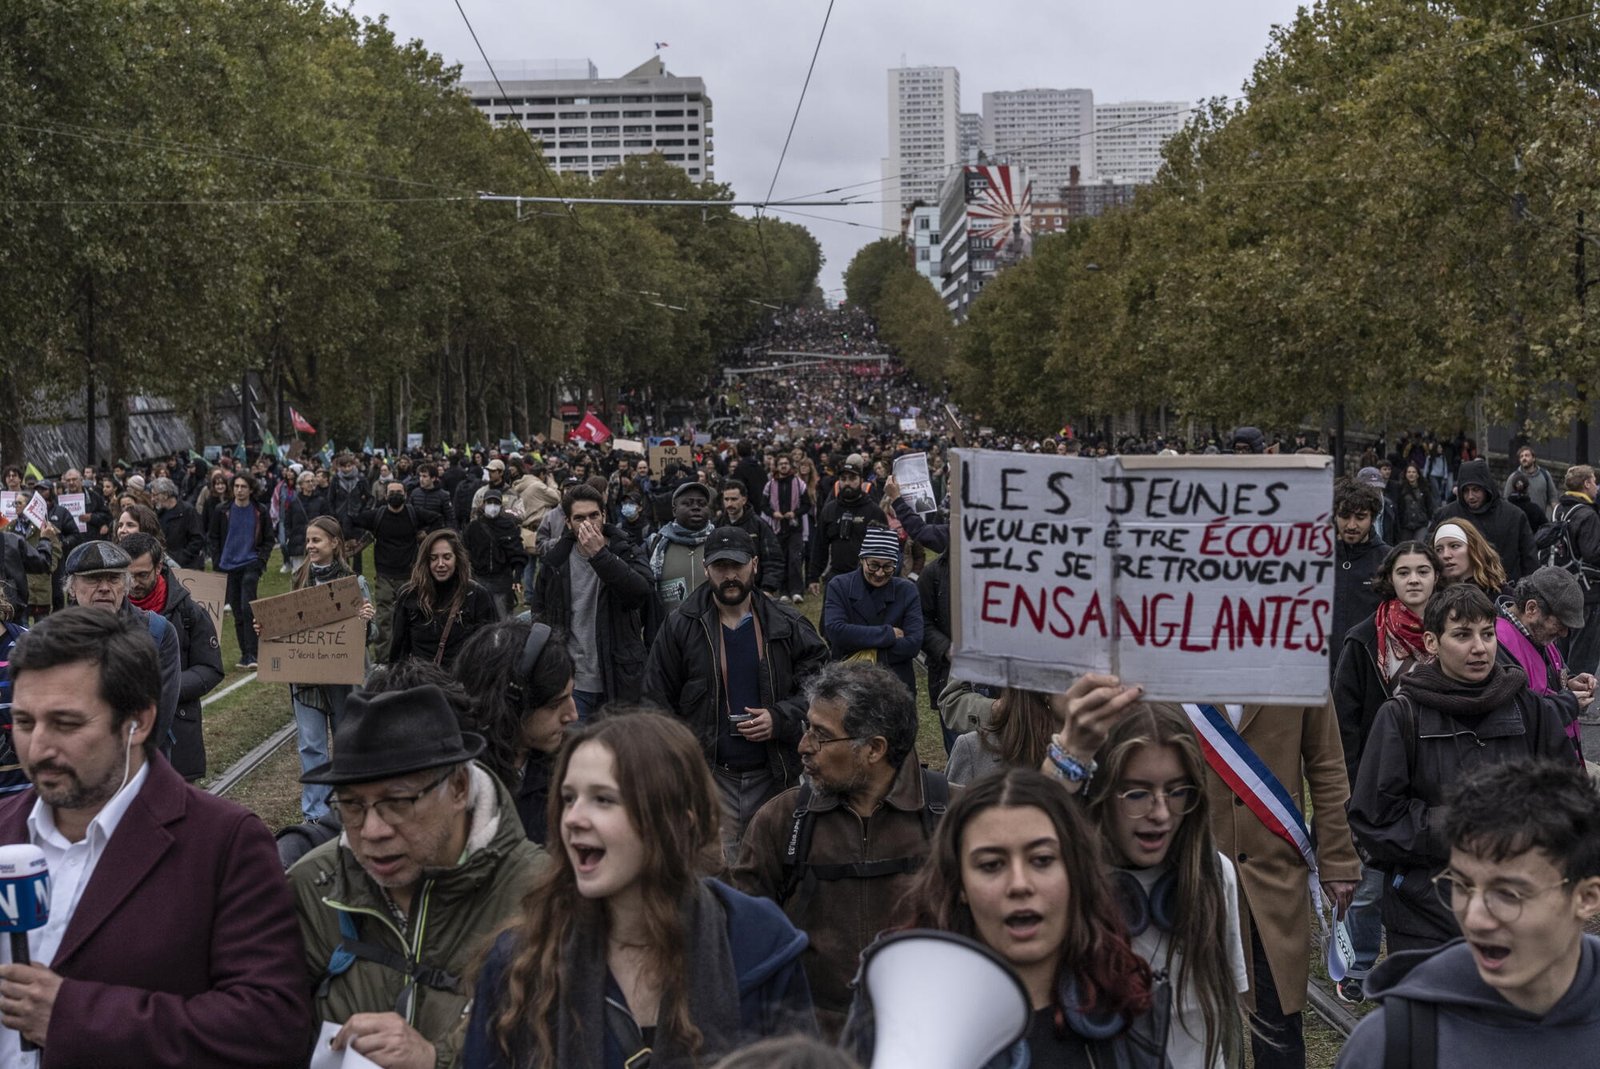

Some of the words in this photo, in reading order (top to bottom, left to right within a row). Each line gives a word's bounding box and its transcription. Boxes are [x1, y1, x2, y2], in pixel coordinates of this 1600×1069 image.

[961, 461, 1073, 515] LES
[1102, 476, 1288, 518] JEUNES
[963, 514, 1093, 547] VEULENT
[1102, 519, 1190, 552] ÊTRE
[970, 547, 1043, 573] ILS
[1055, 551, 1093, 580] SE
[1112, 554, 1334, 585] RETROUVENT
[264, 624, 346, 645] IBERTÉ
[981, 580, 1329, 657] ENSANGLANTÉS.
[331, 652, 349, 660] nom
